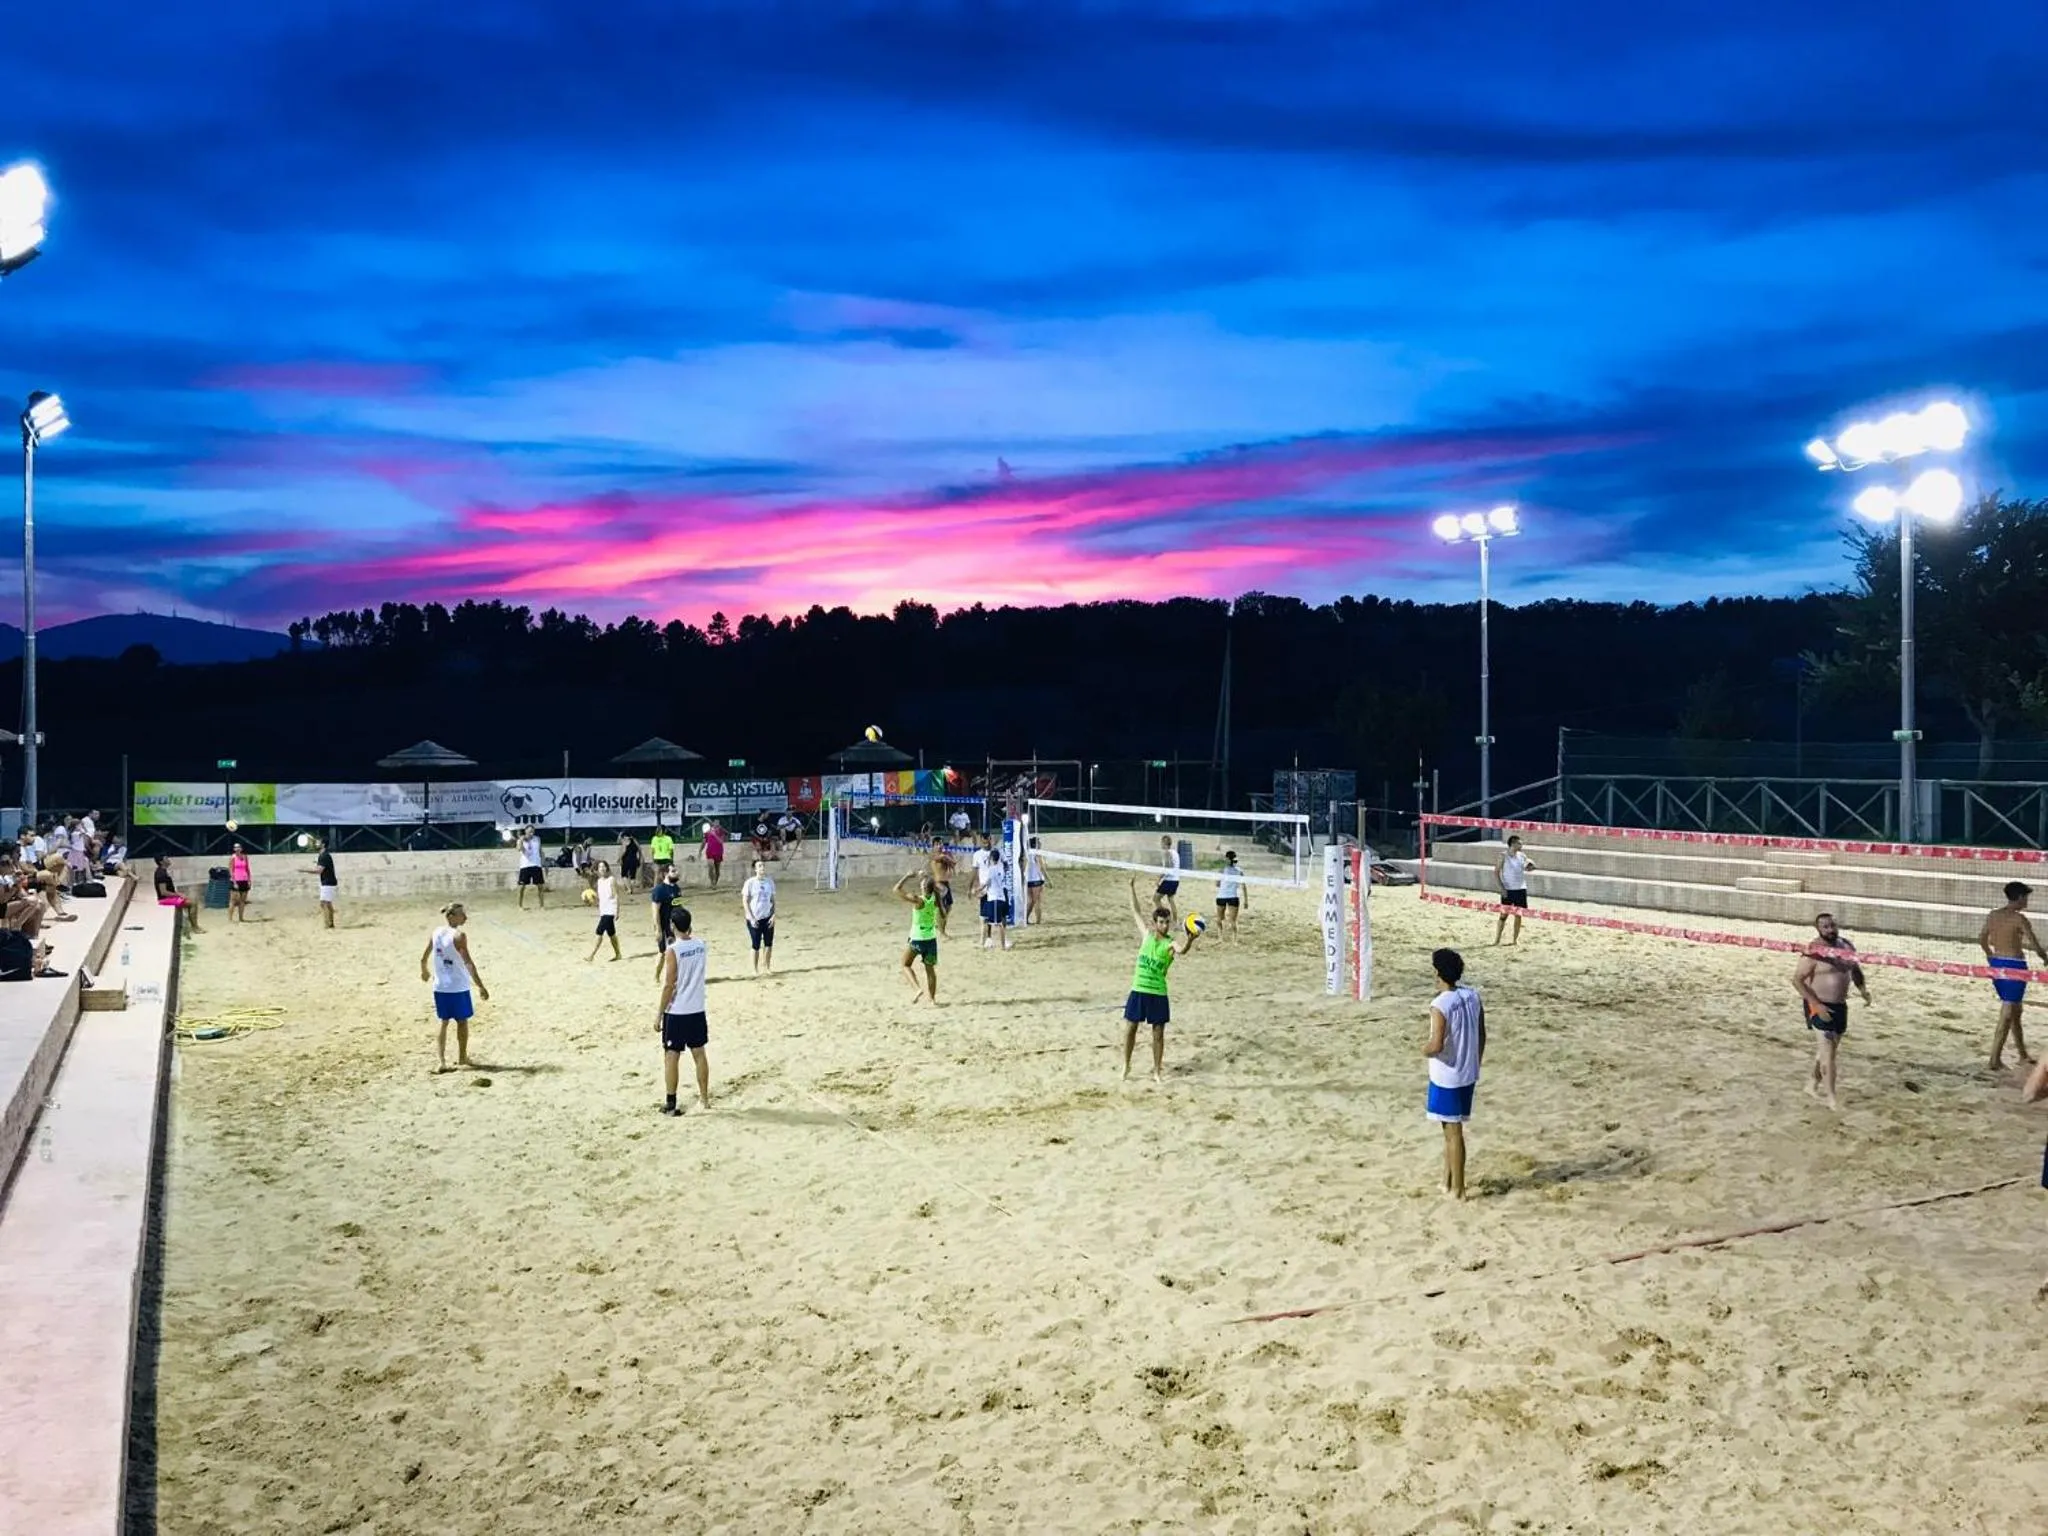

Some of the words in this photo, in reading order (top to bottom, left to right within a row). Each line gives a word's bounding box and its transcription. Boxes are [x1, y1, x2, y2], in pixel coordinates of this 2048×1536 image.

[690, 783, 729, 796] VEGA
[732, 781, 786, 795] SYSTEM
[559, 792, 678, 813] Agrileisuretime
